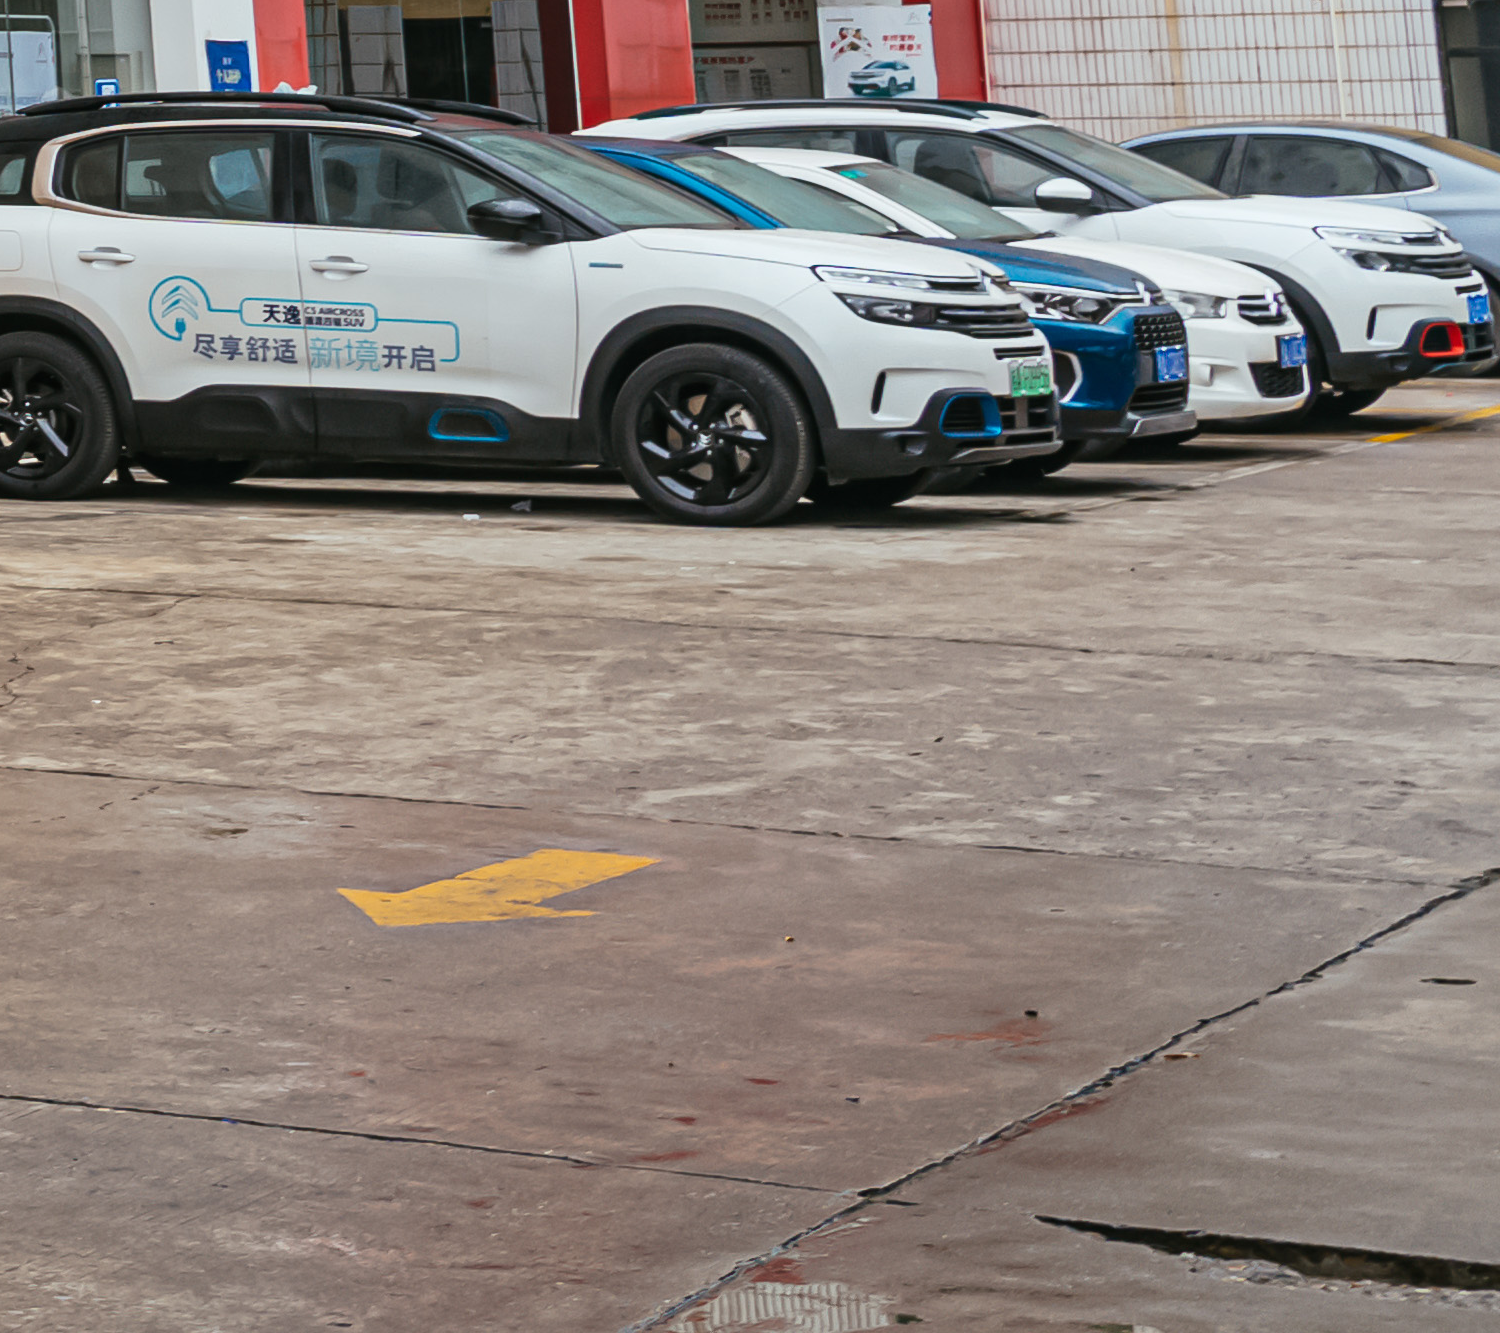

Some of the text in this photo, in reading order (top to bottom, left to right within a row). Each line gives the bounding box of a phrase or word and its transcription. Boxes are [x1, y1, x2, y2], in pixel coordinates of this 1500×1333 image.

[262, 304, 301, 325] 天逸
[192, 332, 436, 372] 尽享舒适 新境开启
